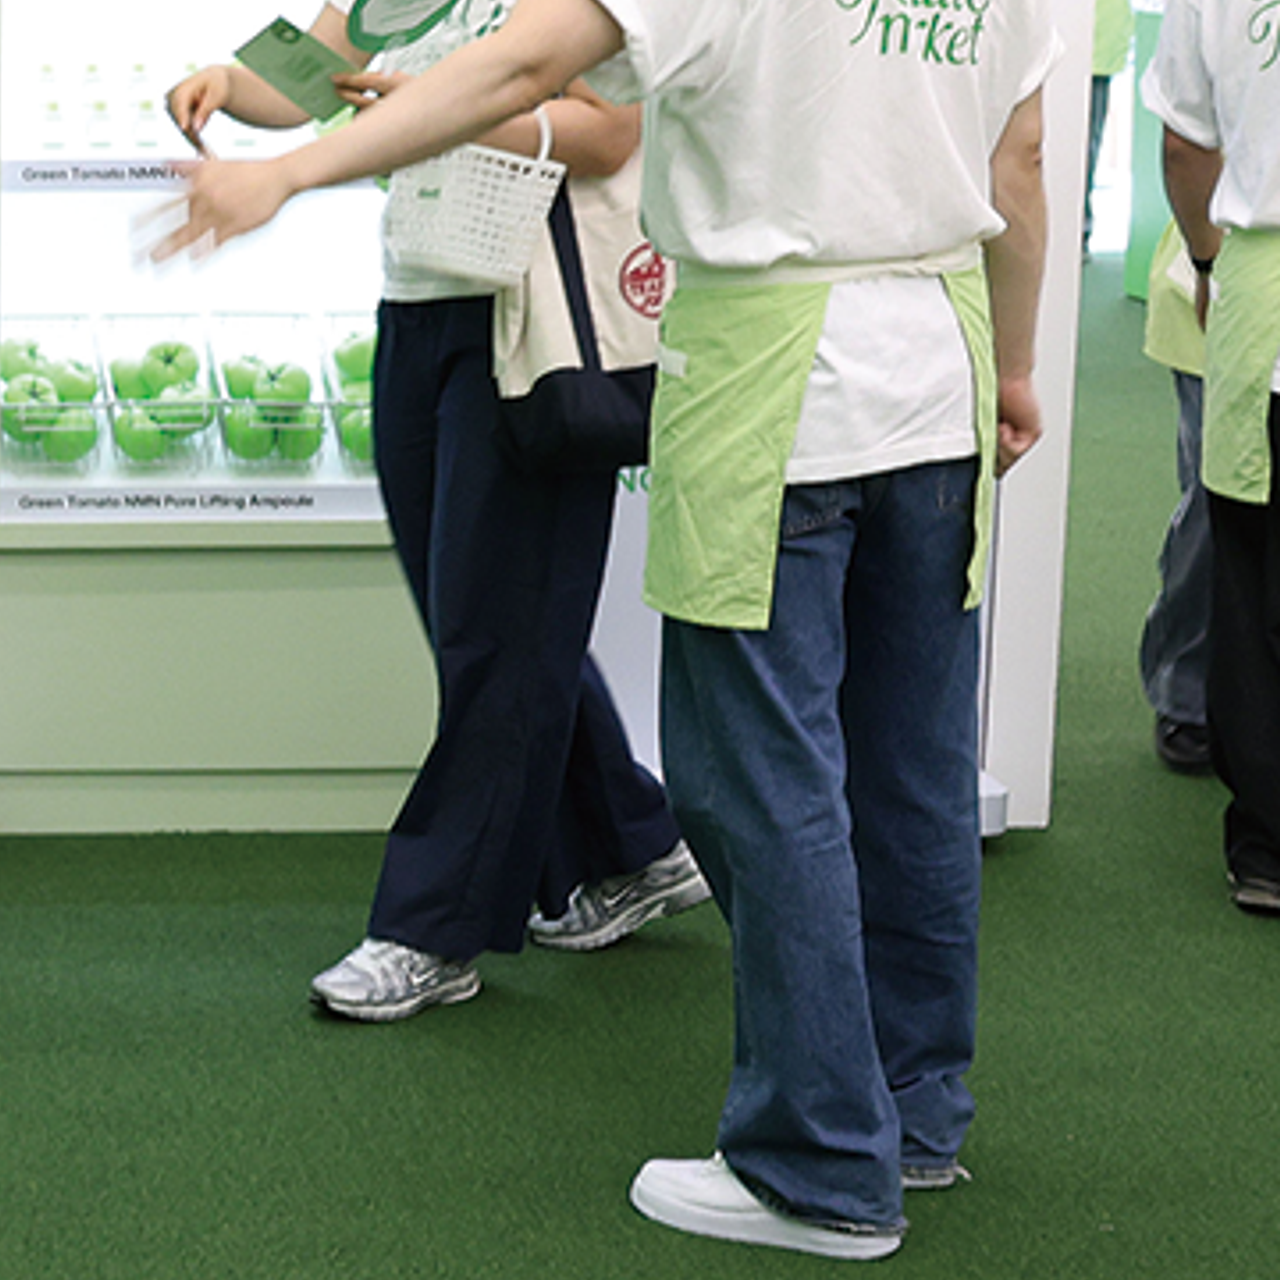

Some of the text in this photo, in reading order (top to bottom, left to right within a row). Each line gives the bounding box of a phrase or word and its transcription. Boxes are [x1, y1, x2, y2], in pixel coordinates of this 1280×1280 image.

[21, 166, 69, 182] Green
[71, 166, 126, 181] Tomato
[128, 165, 169, 180] NMN
[17, 494, 65, 509] Green
[67, 493, 122, 509] Tomato
[163, 493, 196, 509] Pore
[199, 493, 246, 511] Lifting
[250, 493, 314, 510] Ampoule
